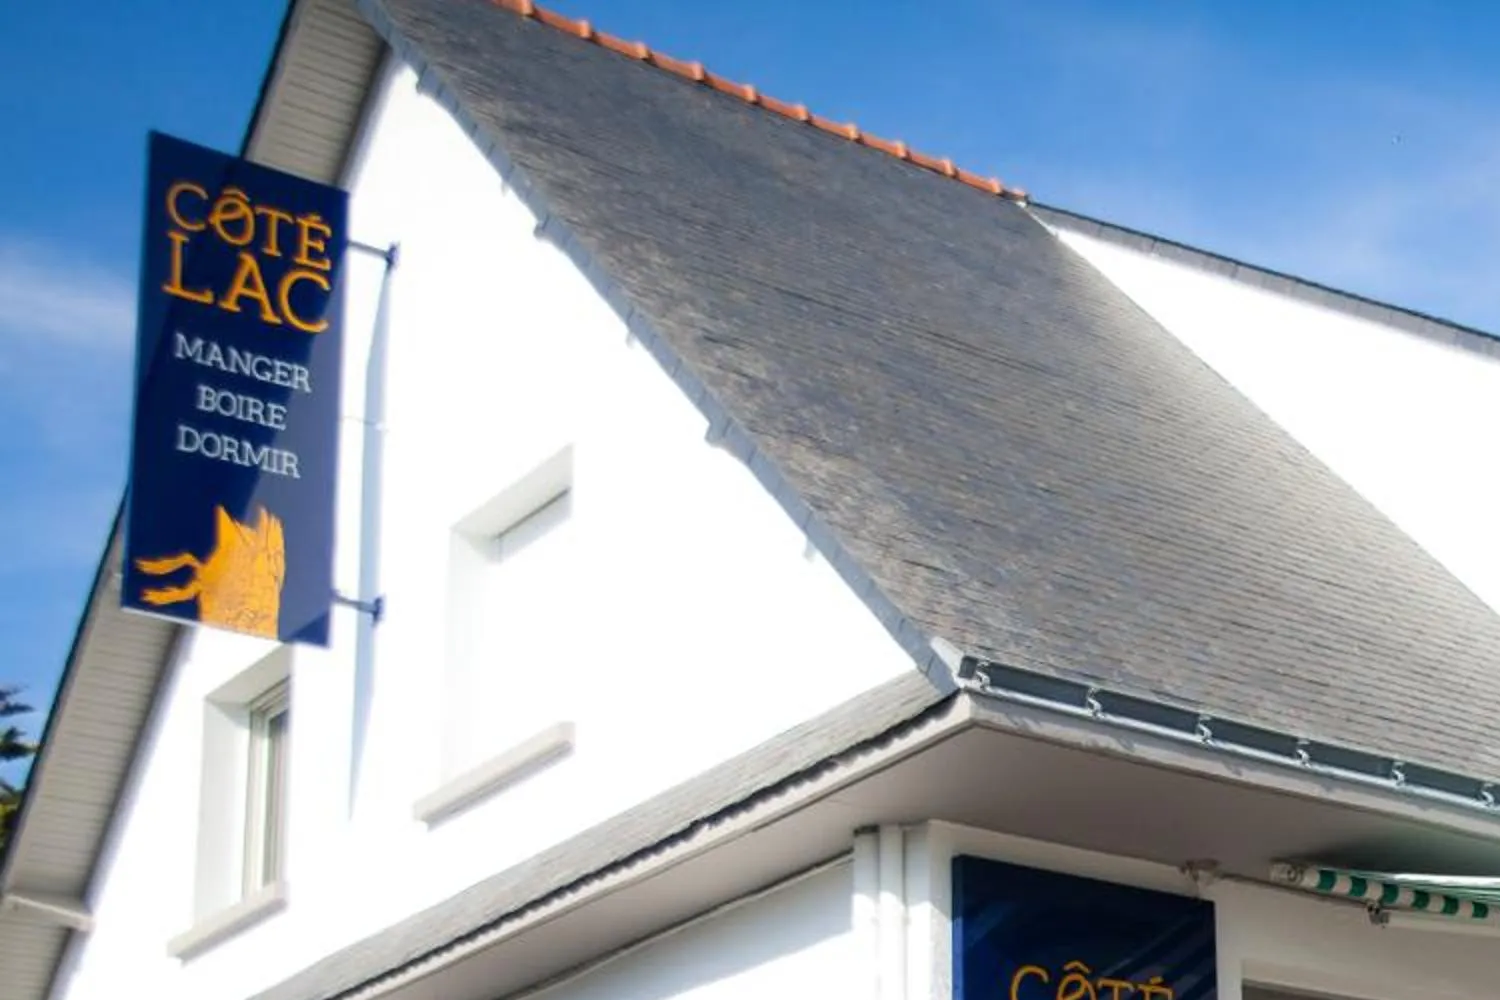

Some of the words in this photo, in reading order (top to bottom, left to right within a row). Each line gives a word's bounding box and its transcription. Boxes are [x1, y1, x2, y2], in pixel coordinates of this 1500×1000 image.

[166, 182, 332, 271] CÔTÉ
[162, 231, 331, 333] LAC
[175, 332, 312, 393] MANGER
[197, 385, 288, 431] BOIRE
[177, 425, 301, 479] DORMIR
